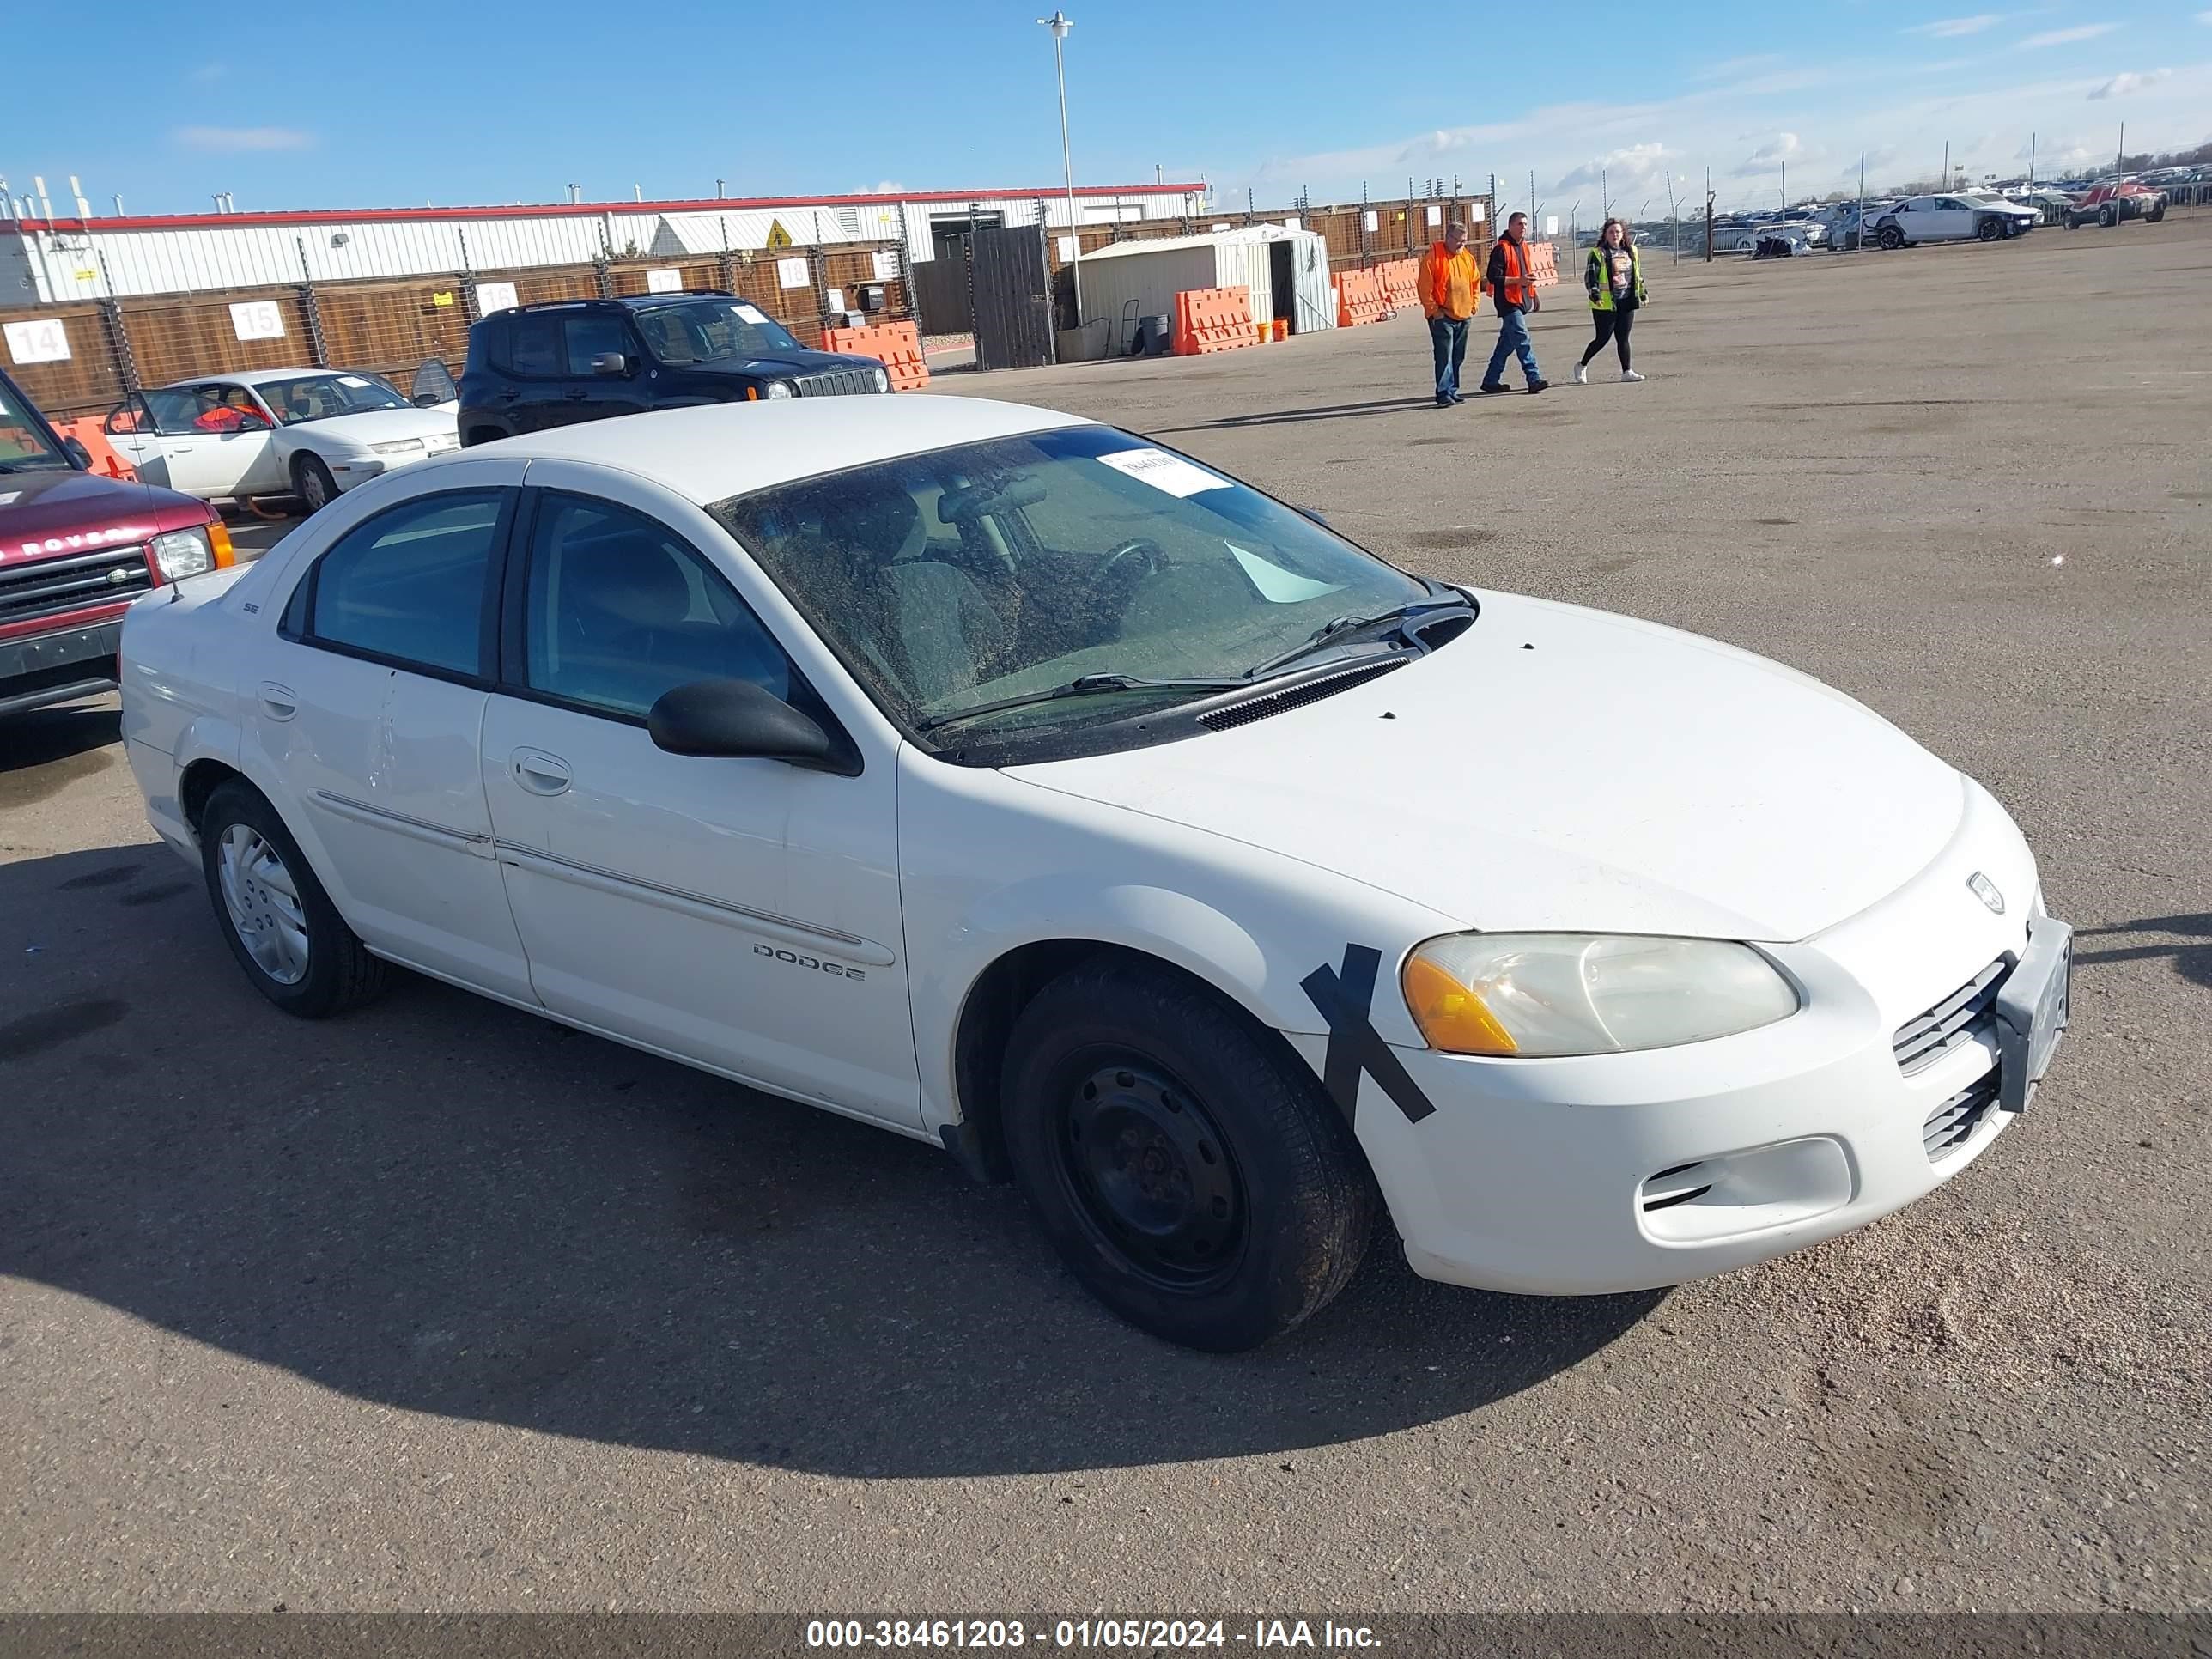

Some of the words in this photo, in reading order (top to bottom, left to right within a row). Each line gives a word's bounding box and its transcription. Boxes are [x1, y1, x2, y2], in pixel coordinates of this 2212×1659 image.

[655, 274, 675, 290] 17
[785, 262, 804, 283] 18
[485, 287, 512, 310] 16
[241, 307, 274, 333] 15
[17, 325, 58, 356] 14
[21, 528, 126, 556] ROVER
[243, 602, 259, 615] SE
[753, 943, 866, 982] DODGE
